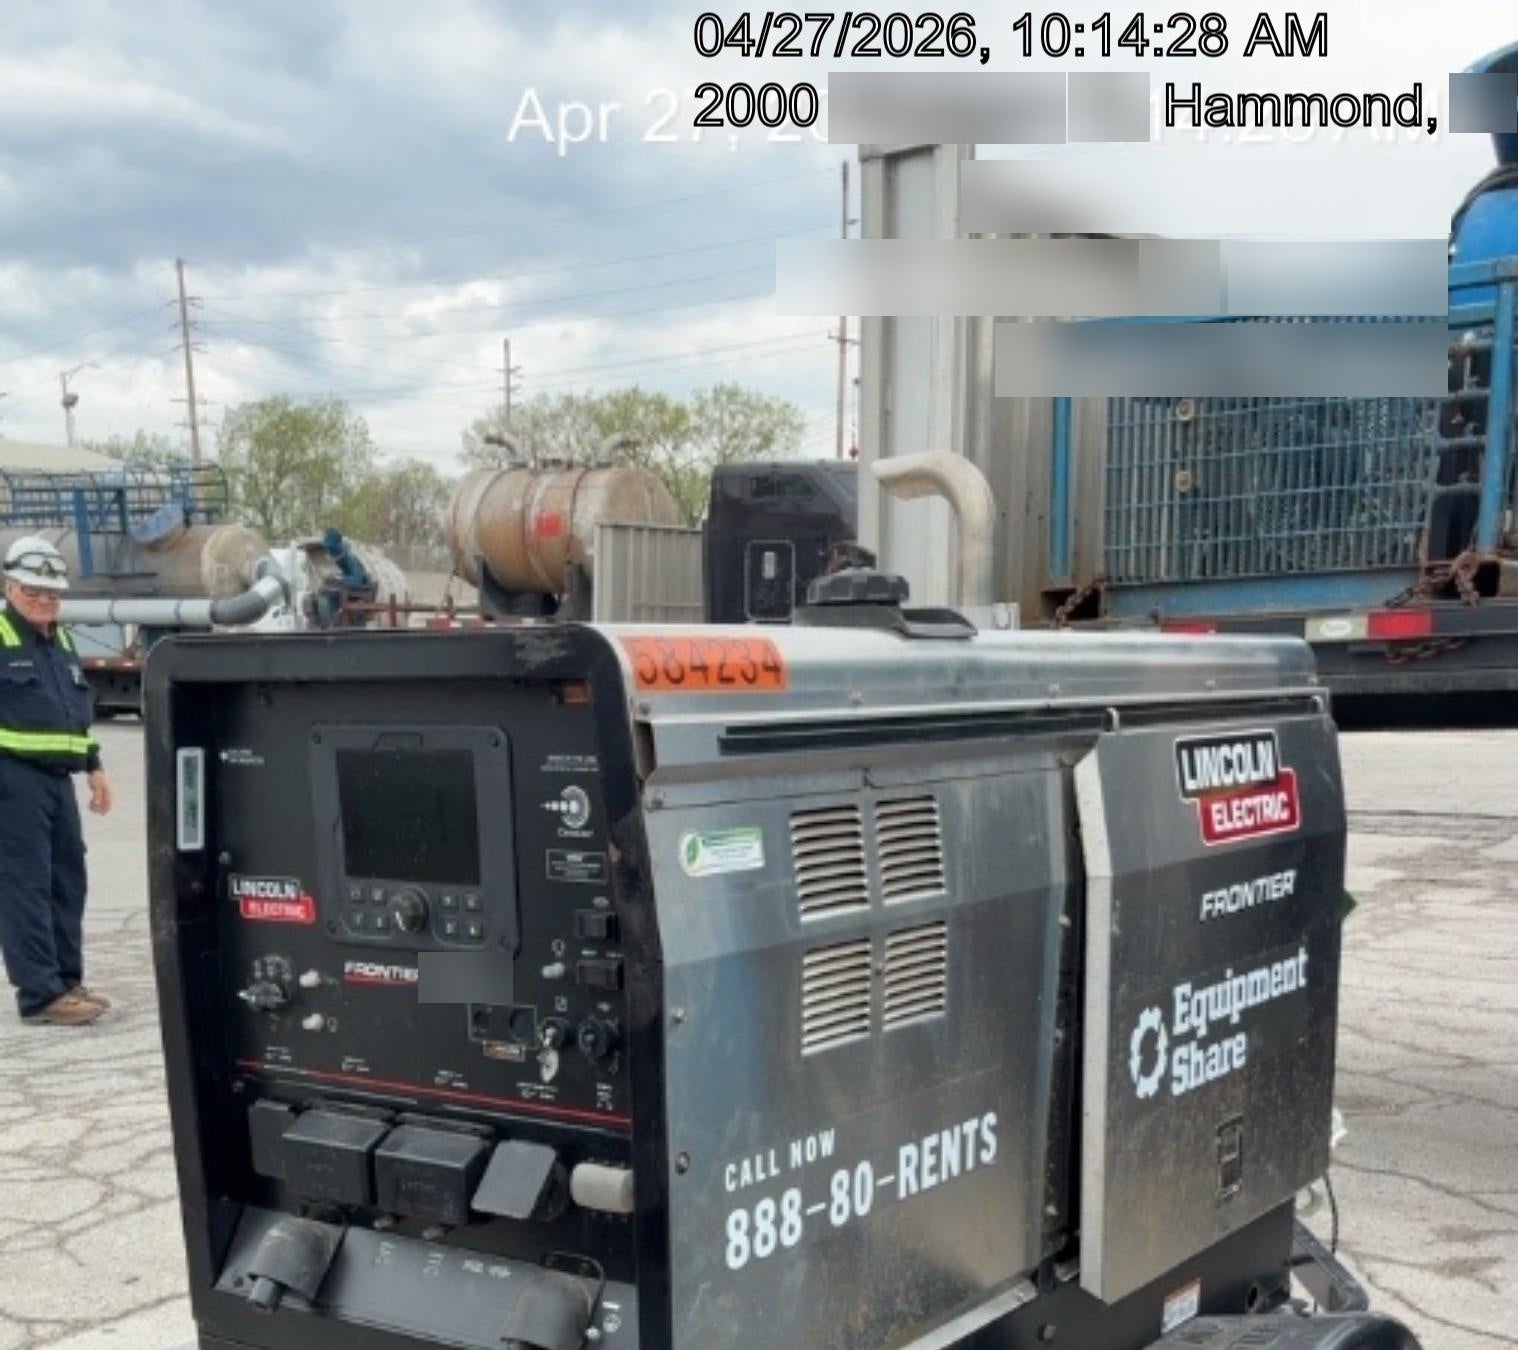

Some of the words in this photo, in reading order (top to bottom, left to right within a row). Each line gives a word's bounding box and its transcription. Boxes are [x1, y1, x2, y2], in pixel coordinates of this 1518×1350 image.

[635, 640, 782, 685] 584234
[1180, 741, 1276, 790] LINCOLN
[1210, 792, 1290, 832] ELECTRIC
[233, 880, 298, 899] LINCOLN
[1200, 870, 1297, 921] FRONTIER
[344, 961, 418, 982] FRONTIE
[1172, 947, 1308, 1038] Equipment
[1171, 1032, 1247, 1096] Share
[725, 1149, 780, 1192] CALL
[790, 1128, 835, 1168] NOW
[725, 1112, 998, 1270] 888-80-RENTS
